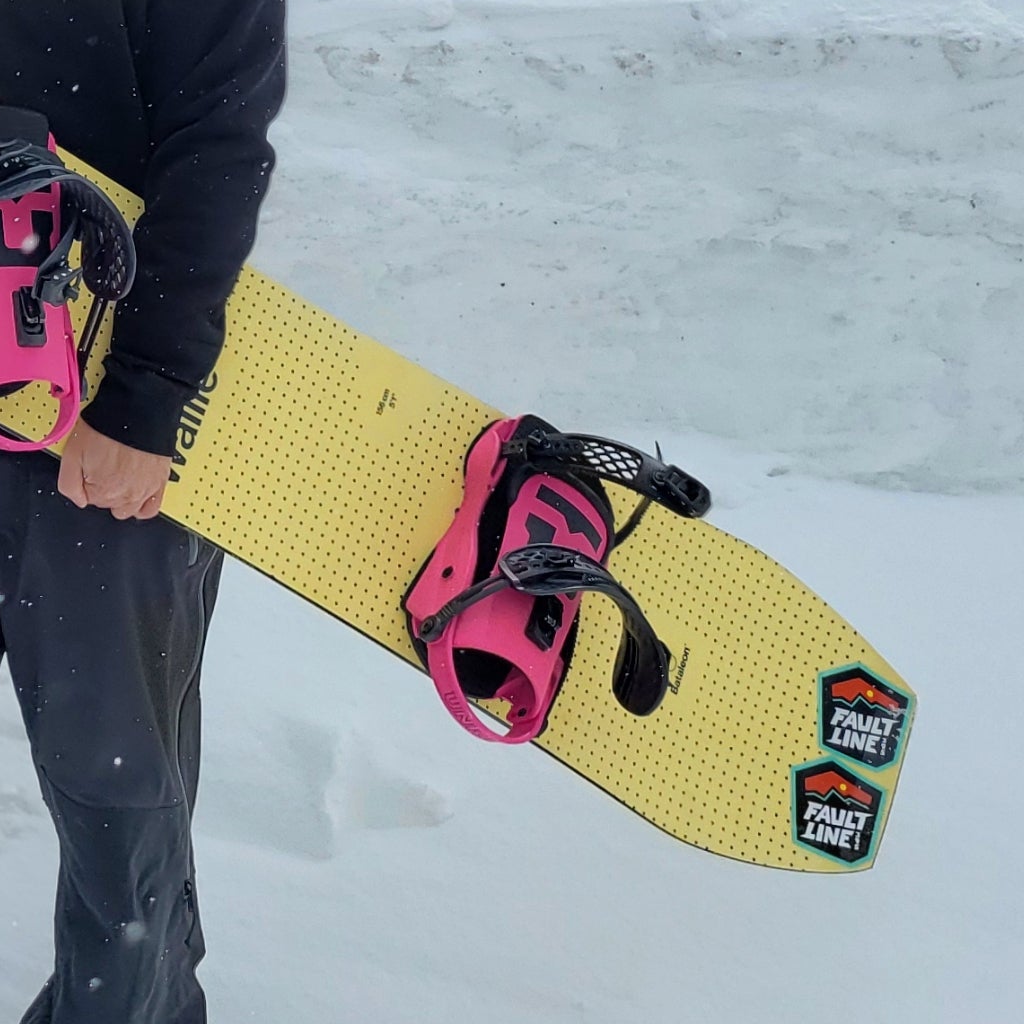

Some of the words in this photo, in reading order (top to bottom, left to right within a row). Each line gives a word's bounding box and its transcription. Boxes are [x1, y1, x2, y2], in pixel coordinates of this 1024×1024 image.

[670, 647, 690, 695] Bataleon
[830, 707, 900, 736] FAULT
[826, 727, 881, 754] LINE
[803, 801, 874, 831] FAULT
[800, 821, 852, 849] LINE
